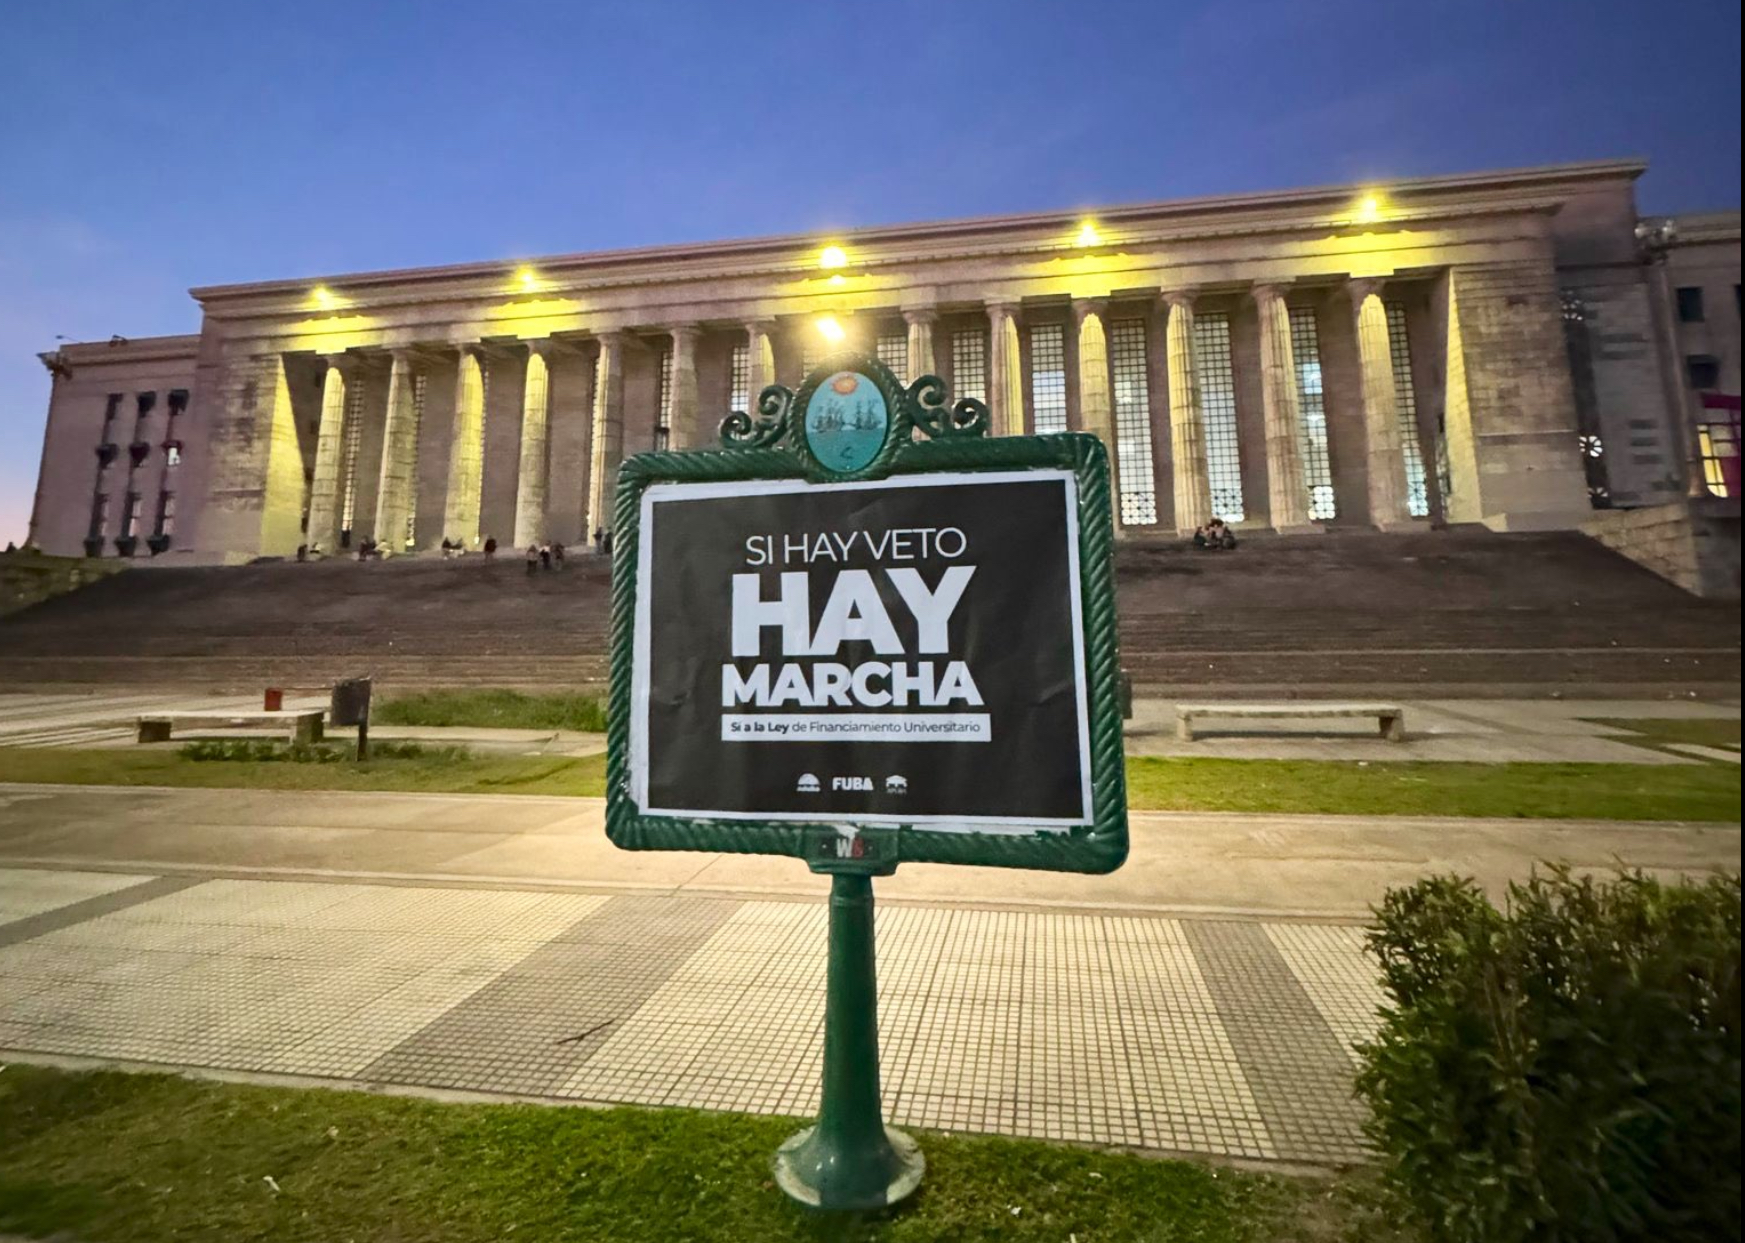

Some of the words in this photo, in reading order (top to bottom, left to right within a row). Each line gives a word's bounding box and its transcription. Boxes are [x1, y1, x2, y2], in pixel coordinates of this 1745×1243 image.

[745, 535, 774, 566] SI
[783, 531, 859, 564] HAY
[862, 526, 968, 561] VETO
[731, 565, 977, 657] HAY
[721, 660, 985, 707] MARCHA
[743, 723, 752, 733] a
[753, 721, 766, 733] la
[767, 721, 790, 735] Ley
[791, 721, 808, 733] de
[809, 720, 902, 733] Financiamiento
[903, 721, 981, 733] Universitario
[832, 776, 874, 791] FUBA
